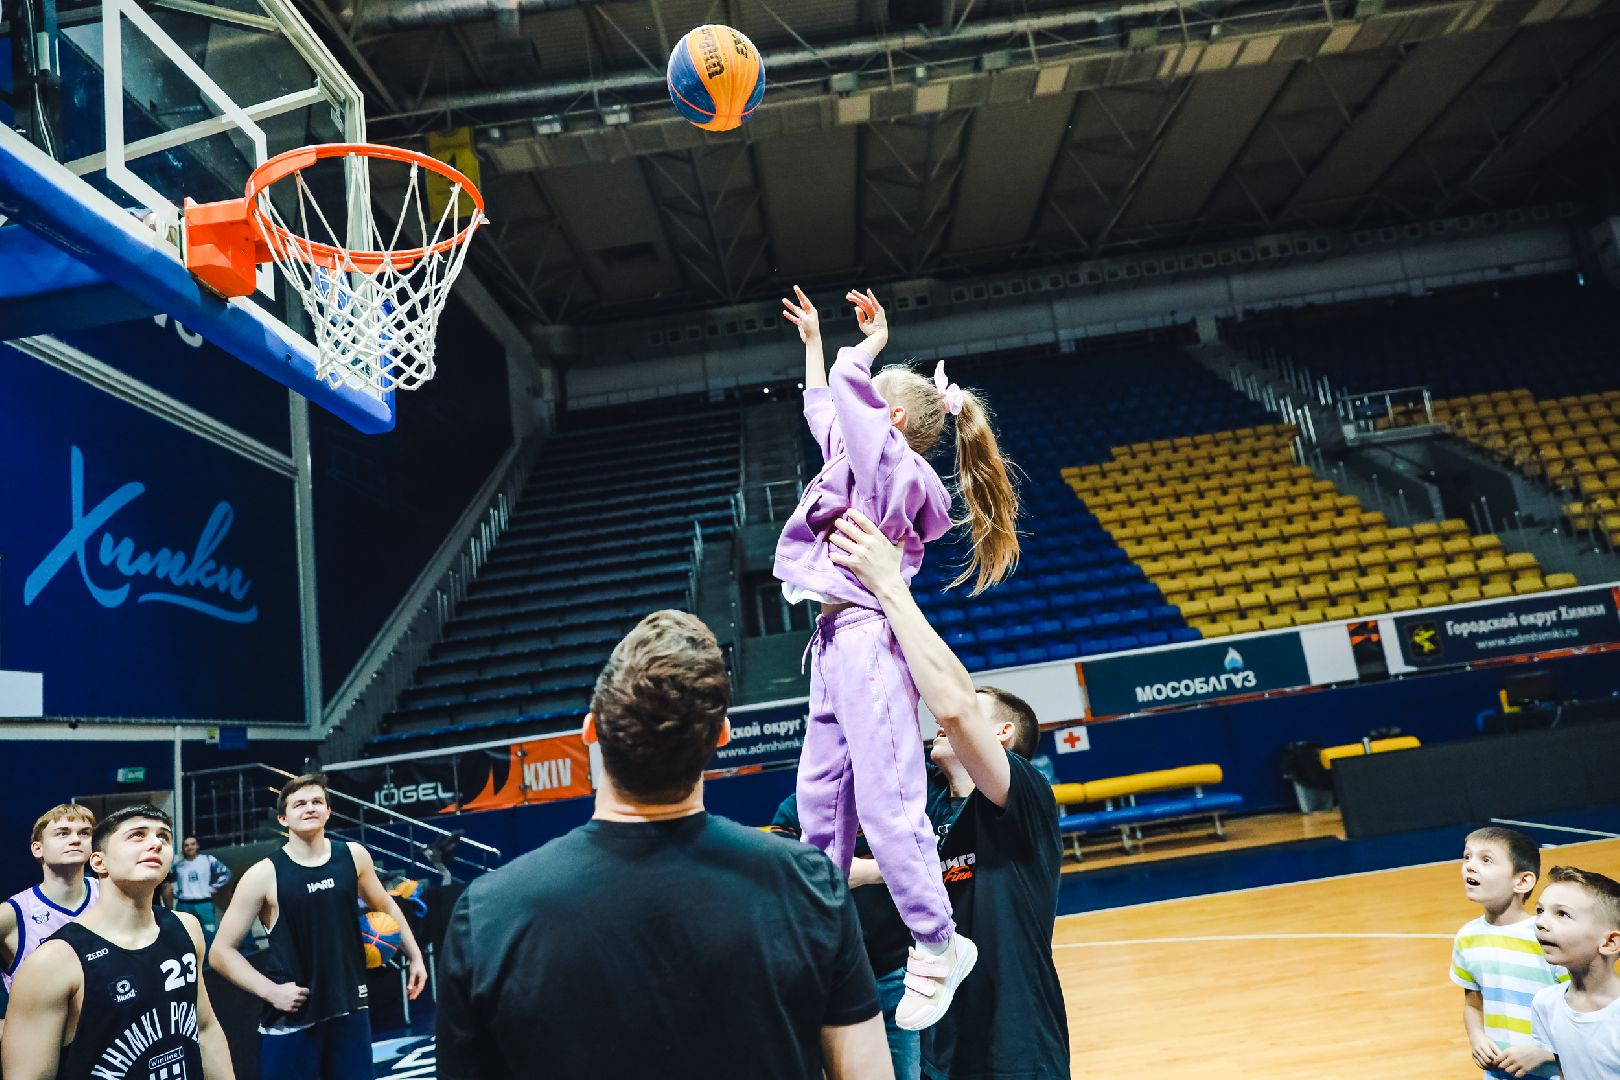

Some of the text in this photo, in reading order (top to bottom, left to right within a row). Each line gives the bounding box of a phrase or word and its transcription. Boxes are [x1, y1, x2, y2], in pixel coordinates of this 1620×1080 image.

[24, 444, 252, 608] Химки
[1446, 604, 1606, 637] Городской округ Химки
[762, 719, 801, 736] округ
[160, 952, 197, 992] 23
[90, 1008, 163, 1080] KHIMKI
